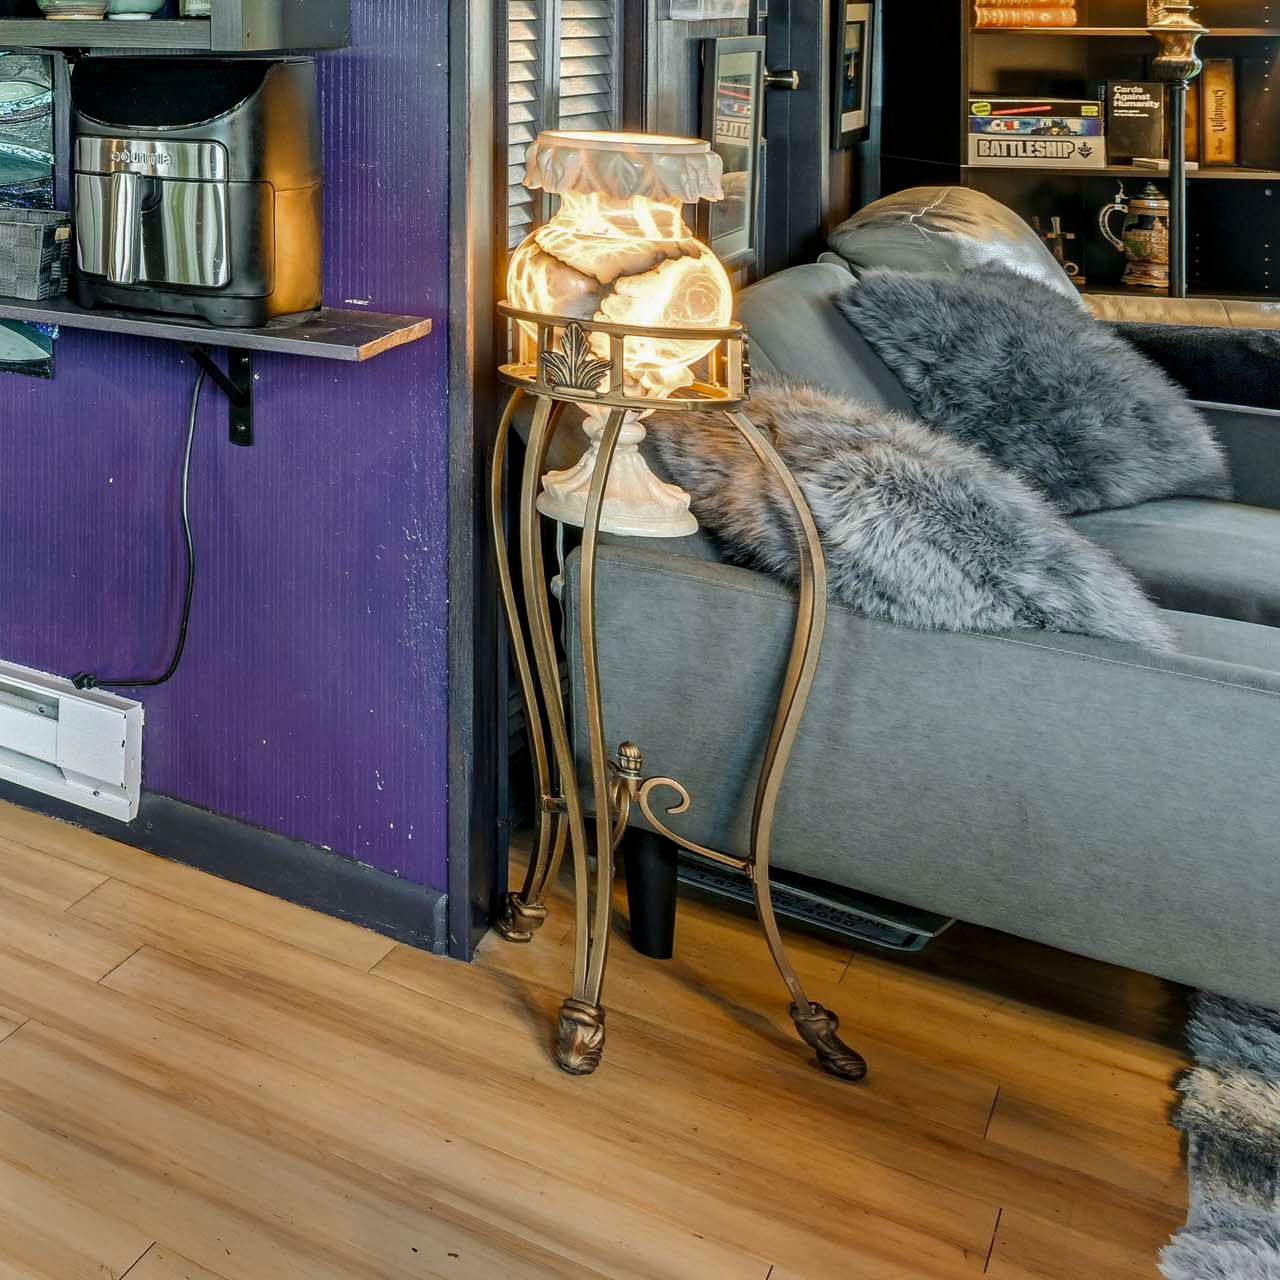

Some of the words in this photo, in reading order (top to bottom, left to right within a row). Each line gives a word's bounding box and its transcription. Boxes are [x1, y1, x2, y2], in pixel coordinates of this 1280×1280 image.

[1114, 93, 1151, 102] Against
[1114, 100, 1159, 109] Humanity
[979, 140, 1074, 158] BATTLESHIP
